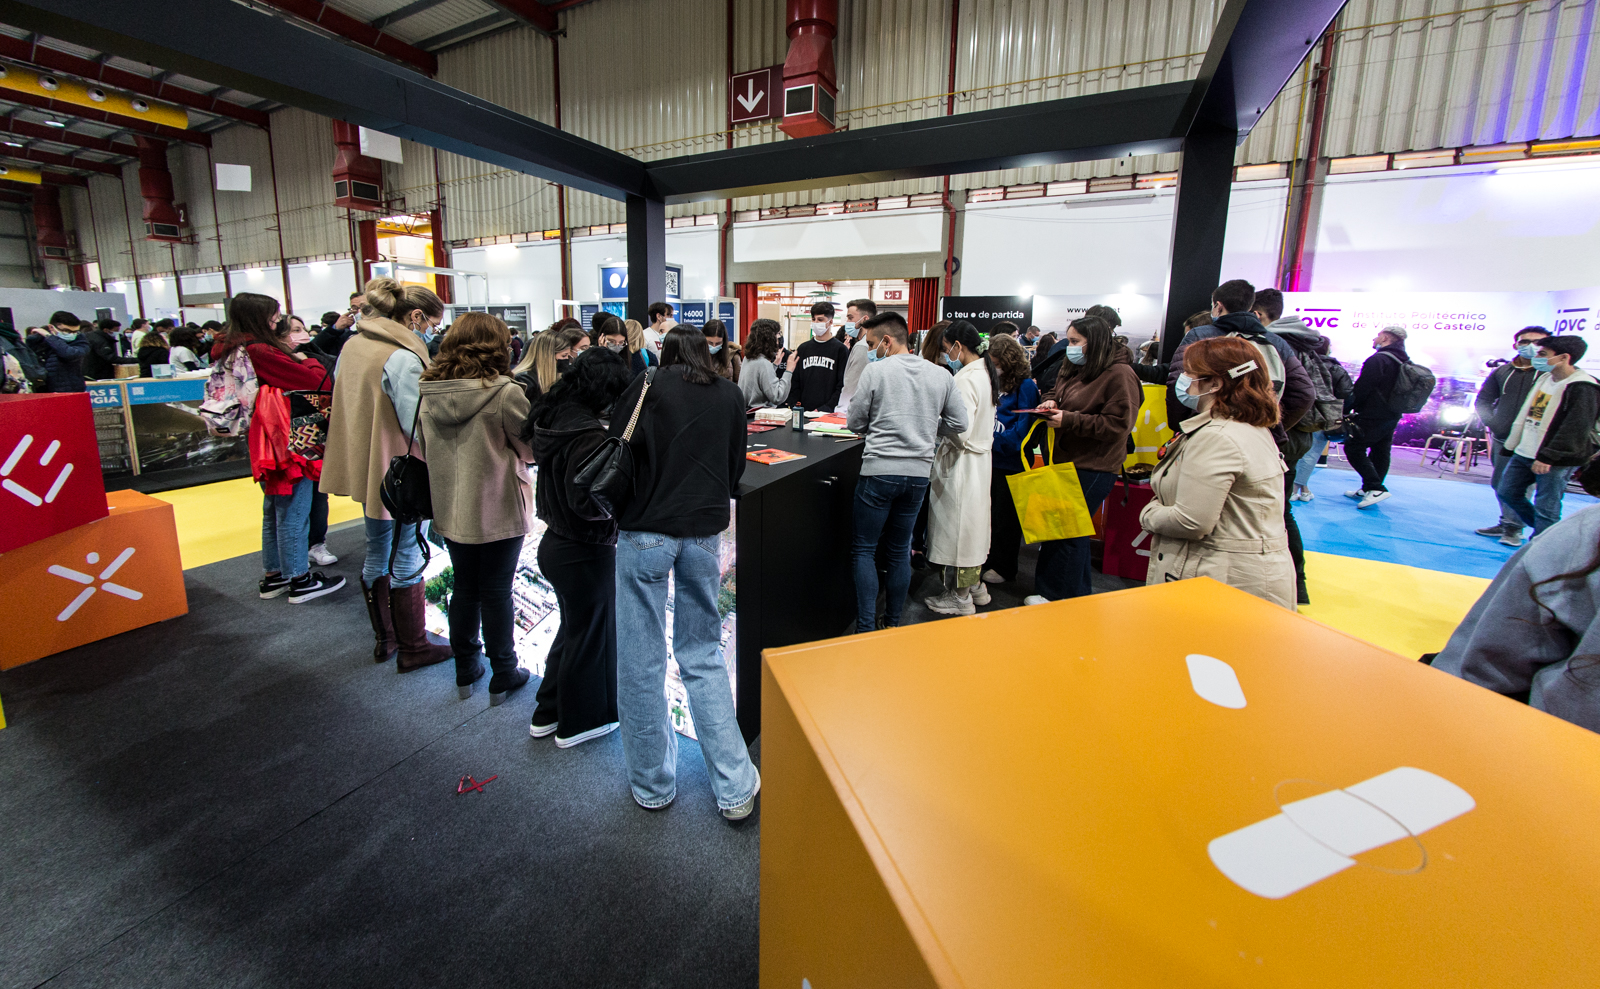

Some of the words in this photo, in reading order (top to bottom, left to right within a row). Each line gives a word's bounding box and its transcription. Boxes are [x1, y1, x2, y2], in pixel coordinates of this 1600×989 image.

[179, 209, 185, 222] 2
[683, 310, 704, 318] +6000
[992, 310, 1024, 320] partida
[1353, 310, 1406, 319] Instituto
[1411, 310, 1487, 320] Politécnico
[1412, 322, 1429, 330] do
[1434, 321, 1486, 331] Castelo
[1553, 309, 1587, 336] ipvc
[802, 355, 835, 370] CARHARTT
